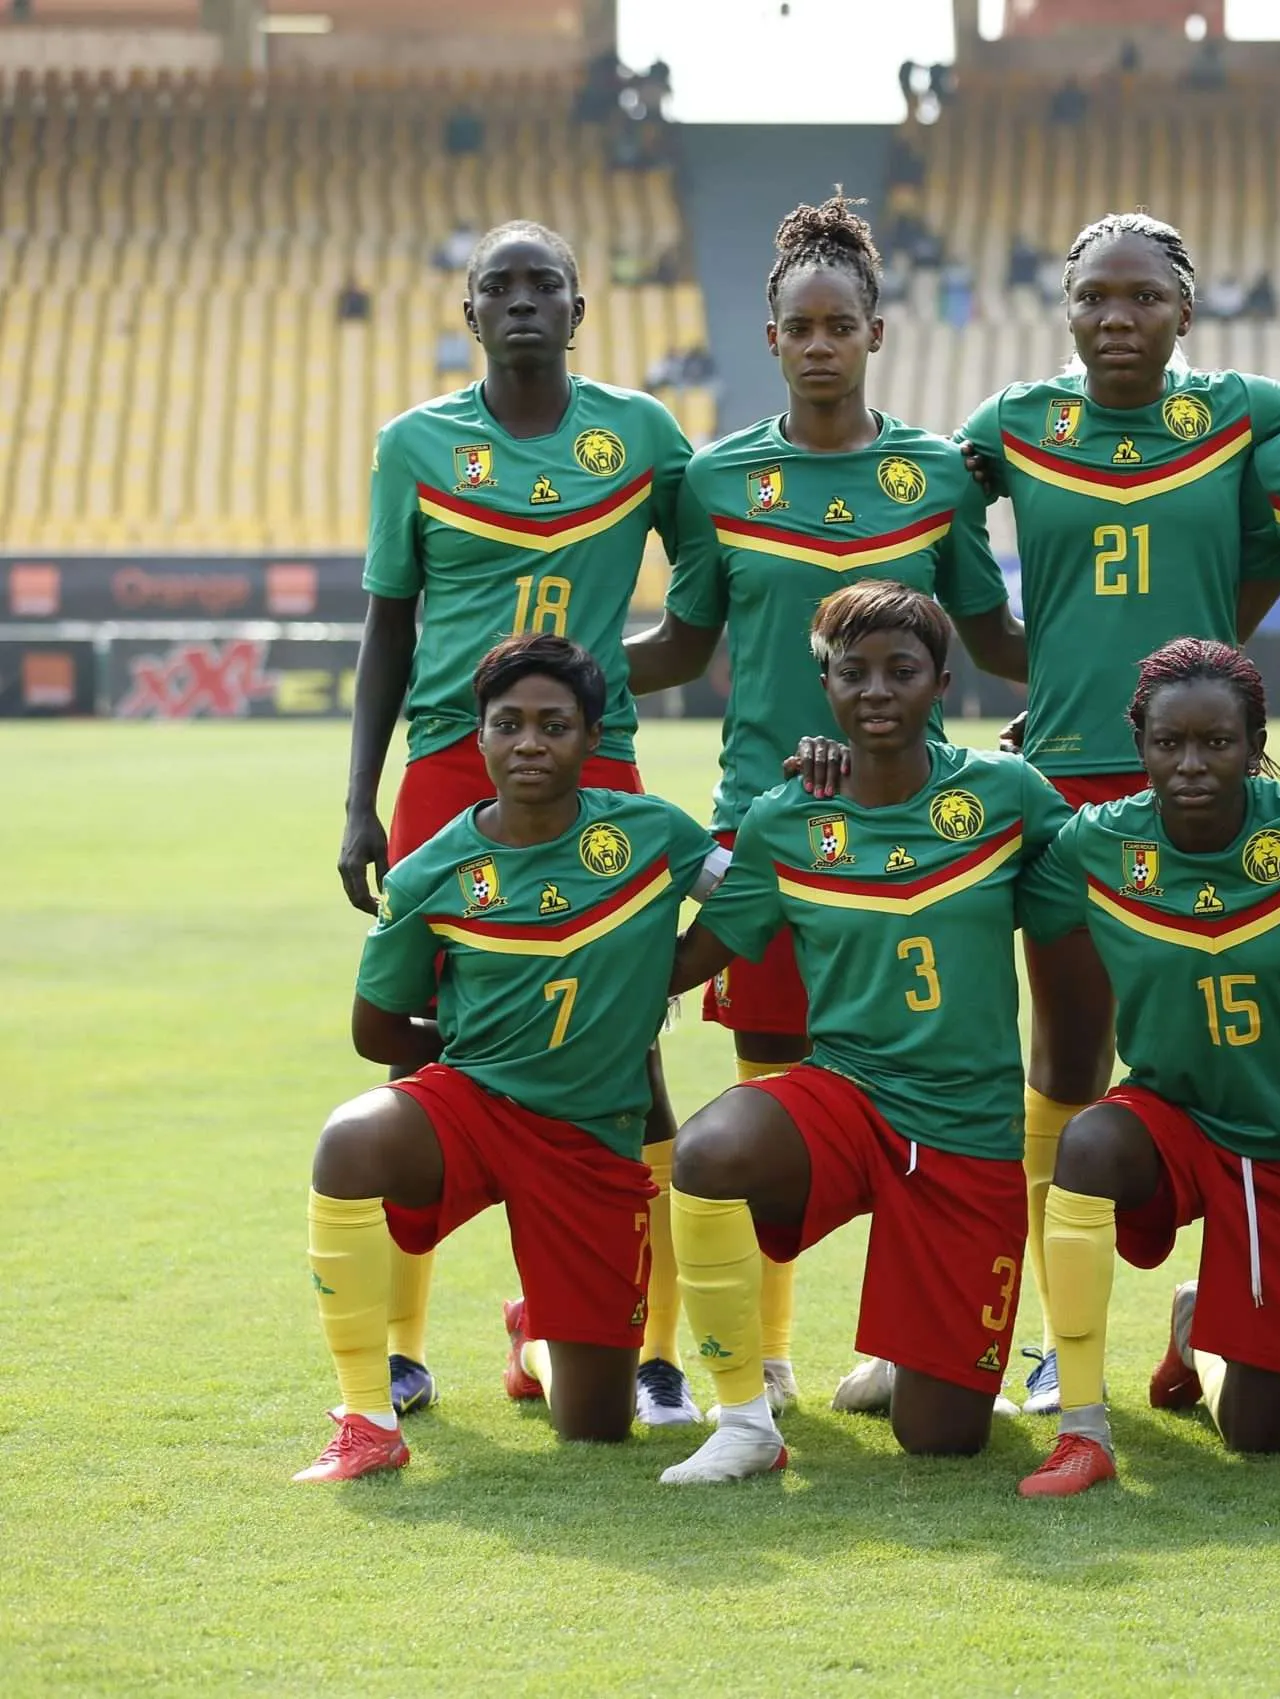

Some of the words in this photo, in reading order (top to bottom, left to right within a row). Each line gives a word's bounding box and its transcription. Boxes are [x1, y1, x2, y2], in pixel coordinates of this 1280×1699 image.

[1094, 524, 1149, 595] 21
[513, 575, 572, 637] 18
[897, 936, 942, 1012] 3
[1197, 974, 1261, 1046] 15
[544, 978, 578, 1049] 7
[635, 1212, 649, 1285] 7
[982, 1256, 1017, 1331] 3
